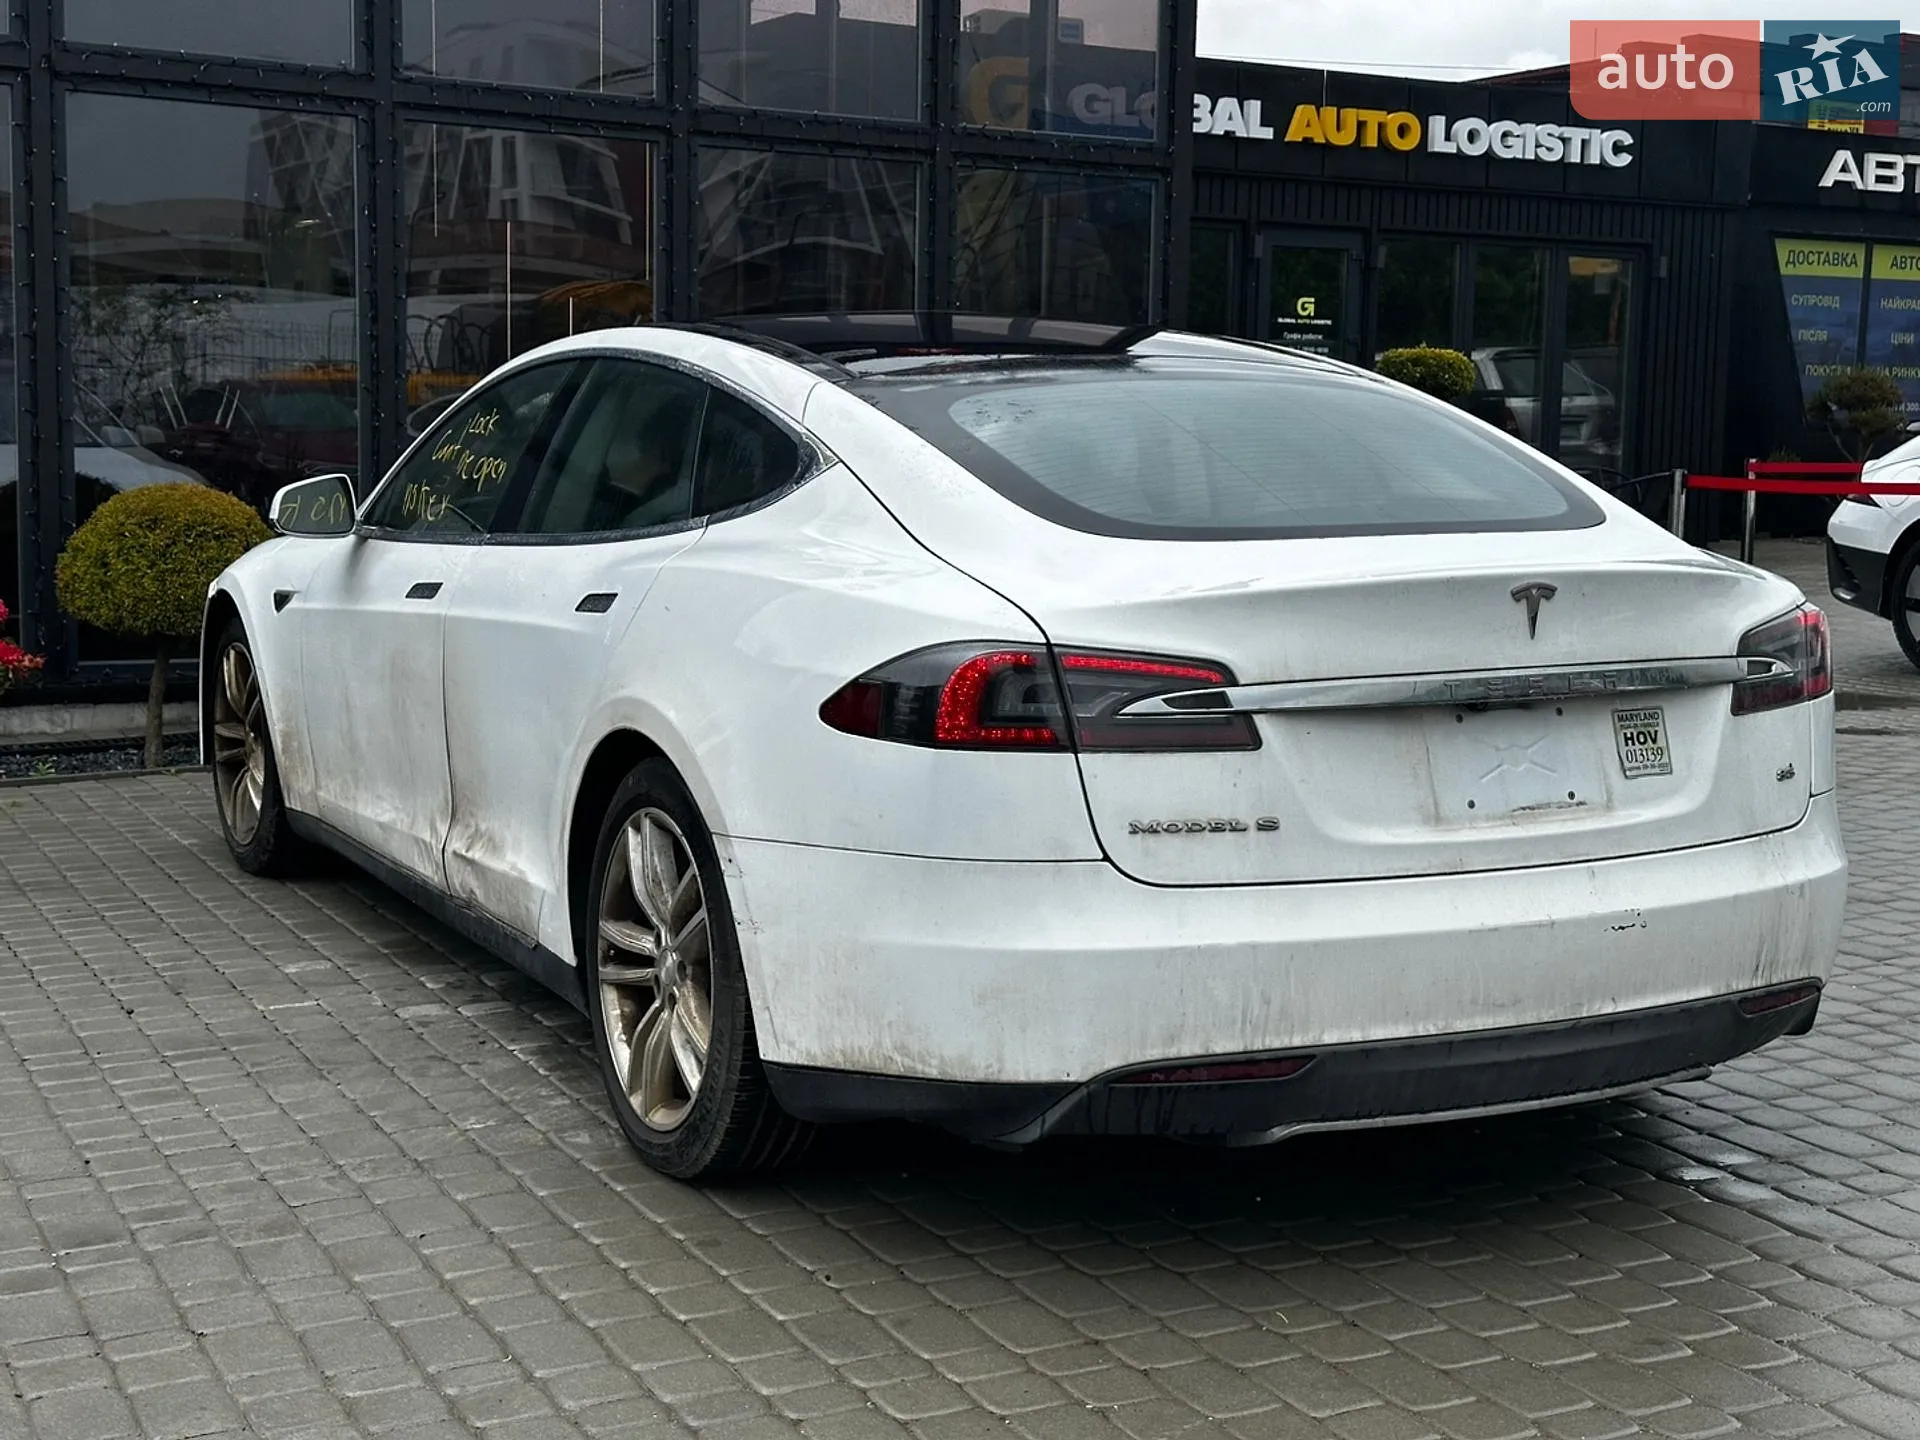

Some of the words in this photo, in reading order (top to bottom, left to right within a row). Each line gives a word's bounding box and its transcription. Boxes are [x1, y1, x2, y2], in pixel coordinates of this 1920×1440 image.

[1283, 104, 1421, 152] AUTO
[1427, 115, 1635, 167] LOGISTIC
[1785, 249, 1858, 268] ДОСТАВКА
[1791, 294, 1840, 309] СУПРОВІД
[1798, 329, 1828, 342] ПІСЛЯ
[1891, 332, 1914, 345] ЦІНИ
[1617, 711, 1660, 722] MARYLAND
[1624, 730, 1659, 747] HOV
[1626, 747, 1664, 764] 013139
[1128, 818, 1249, 834] MODEL
[1256, 816, 1280, 831] S
